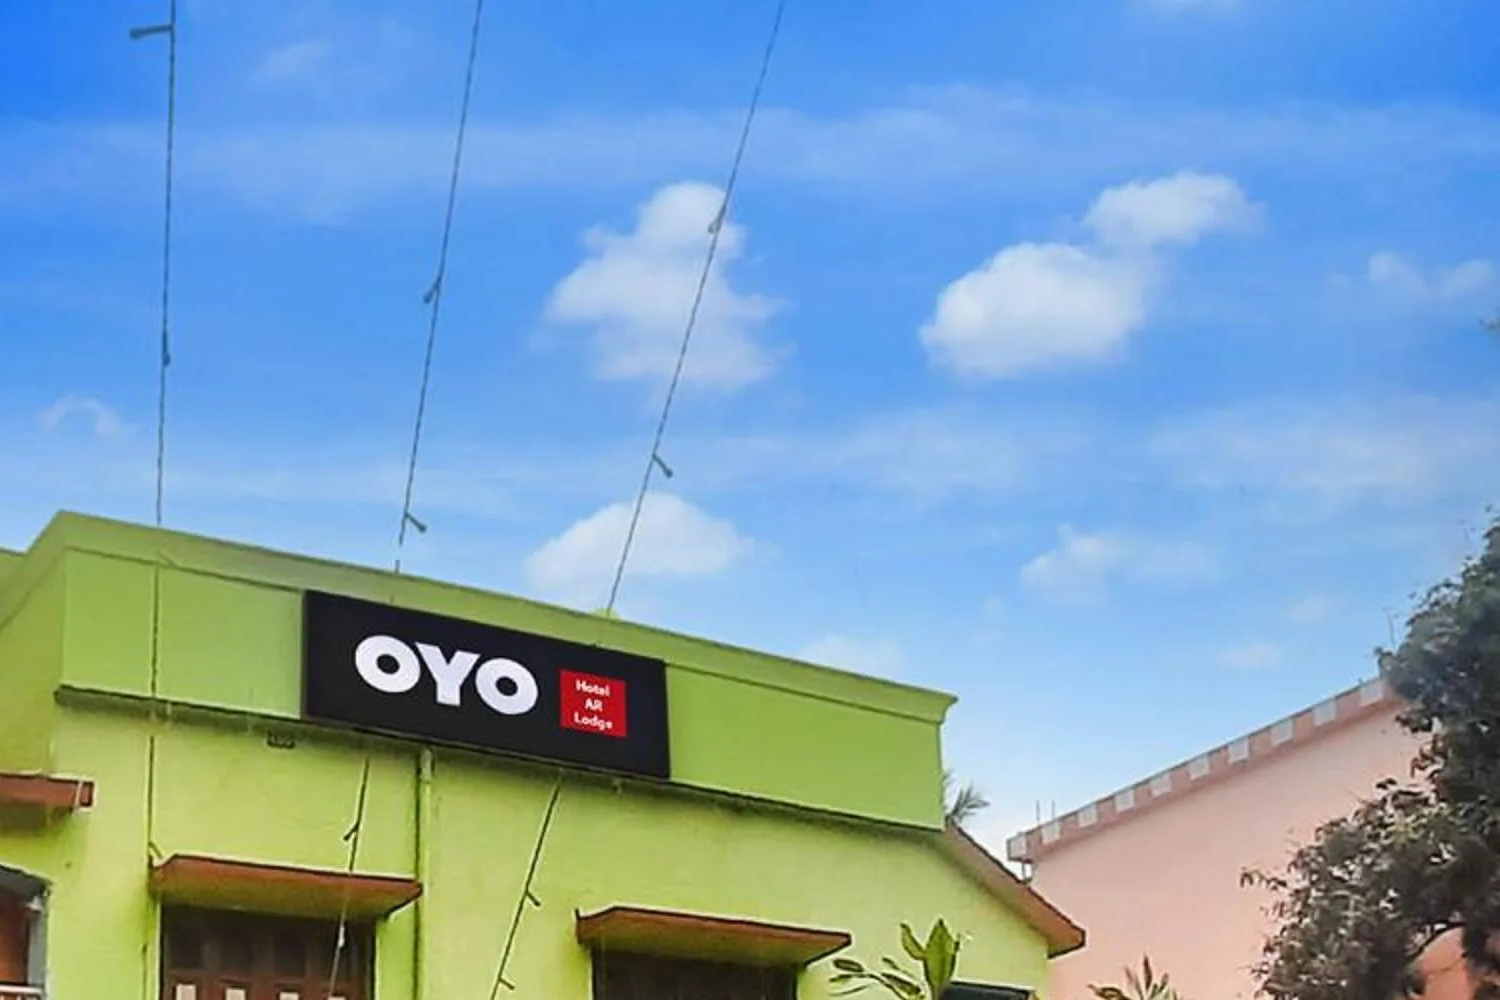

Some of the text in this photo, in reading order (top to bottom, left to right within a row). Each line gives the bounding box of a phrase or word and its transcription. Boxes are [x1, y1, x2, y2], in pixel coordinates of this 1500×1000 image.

[355, 634, 539, 716] OYO
[575, 679, 610, 697] Hotel
[585, 698, 603, 712] AR
[573, 711, 612, 731] Lodge
